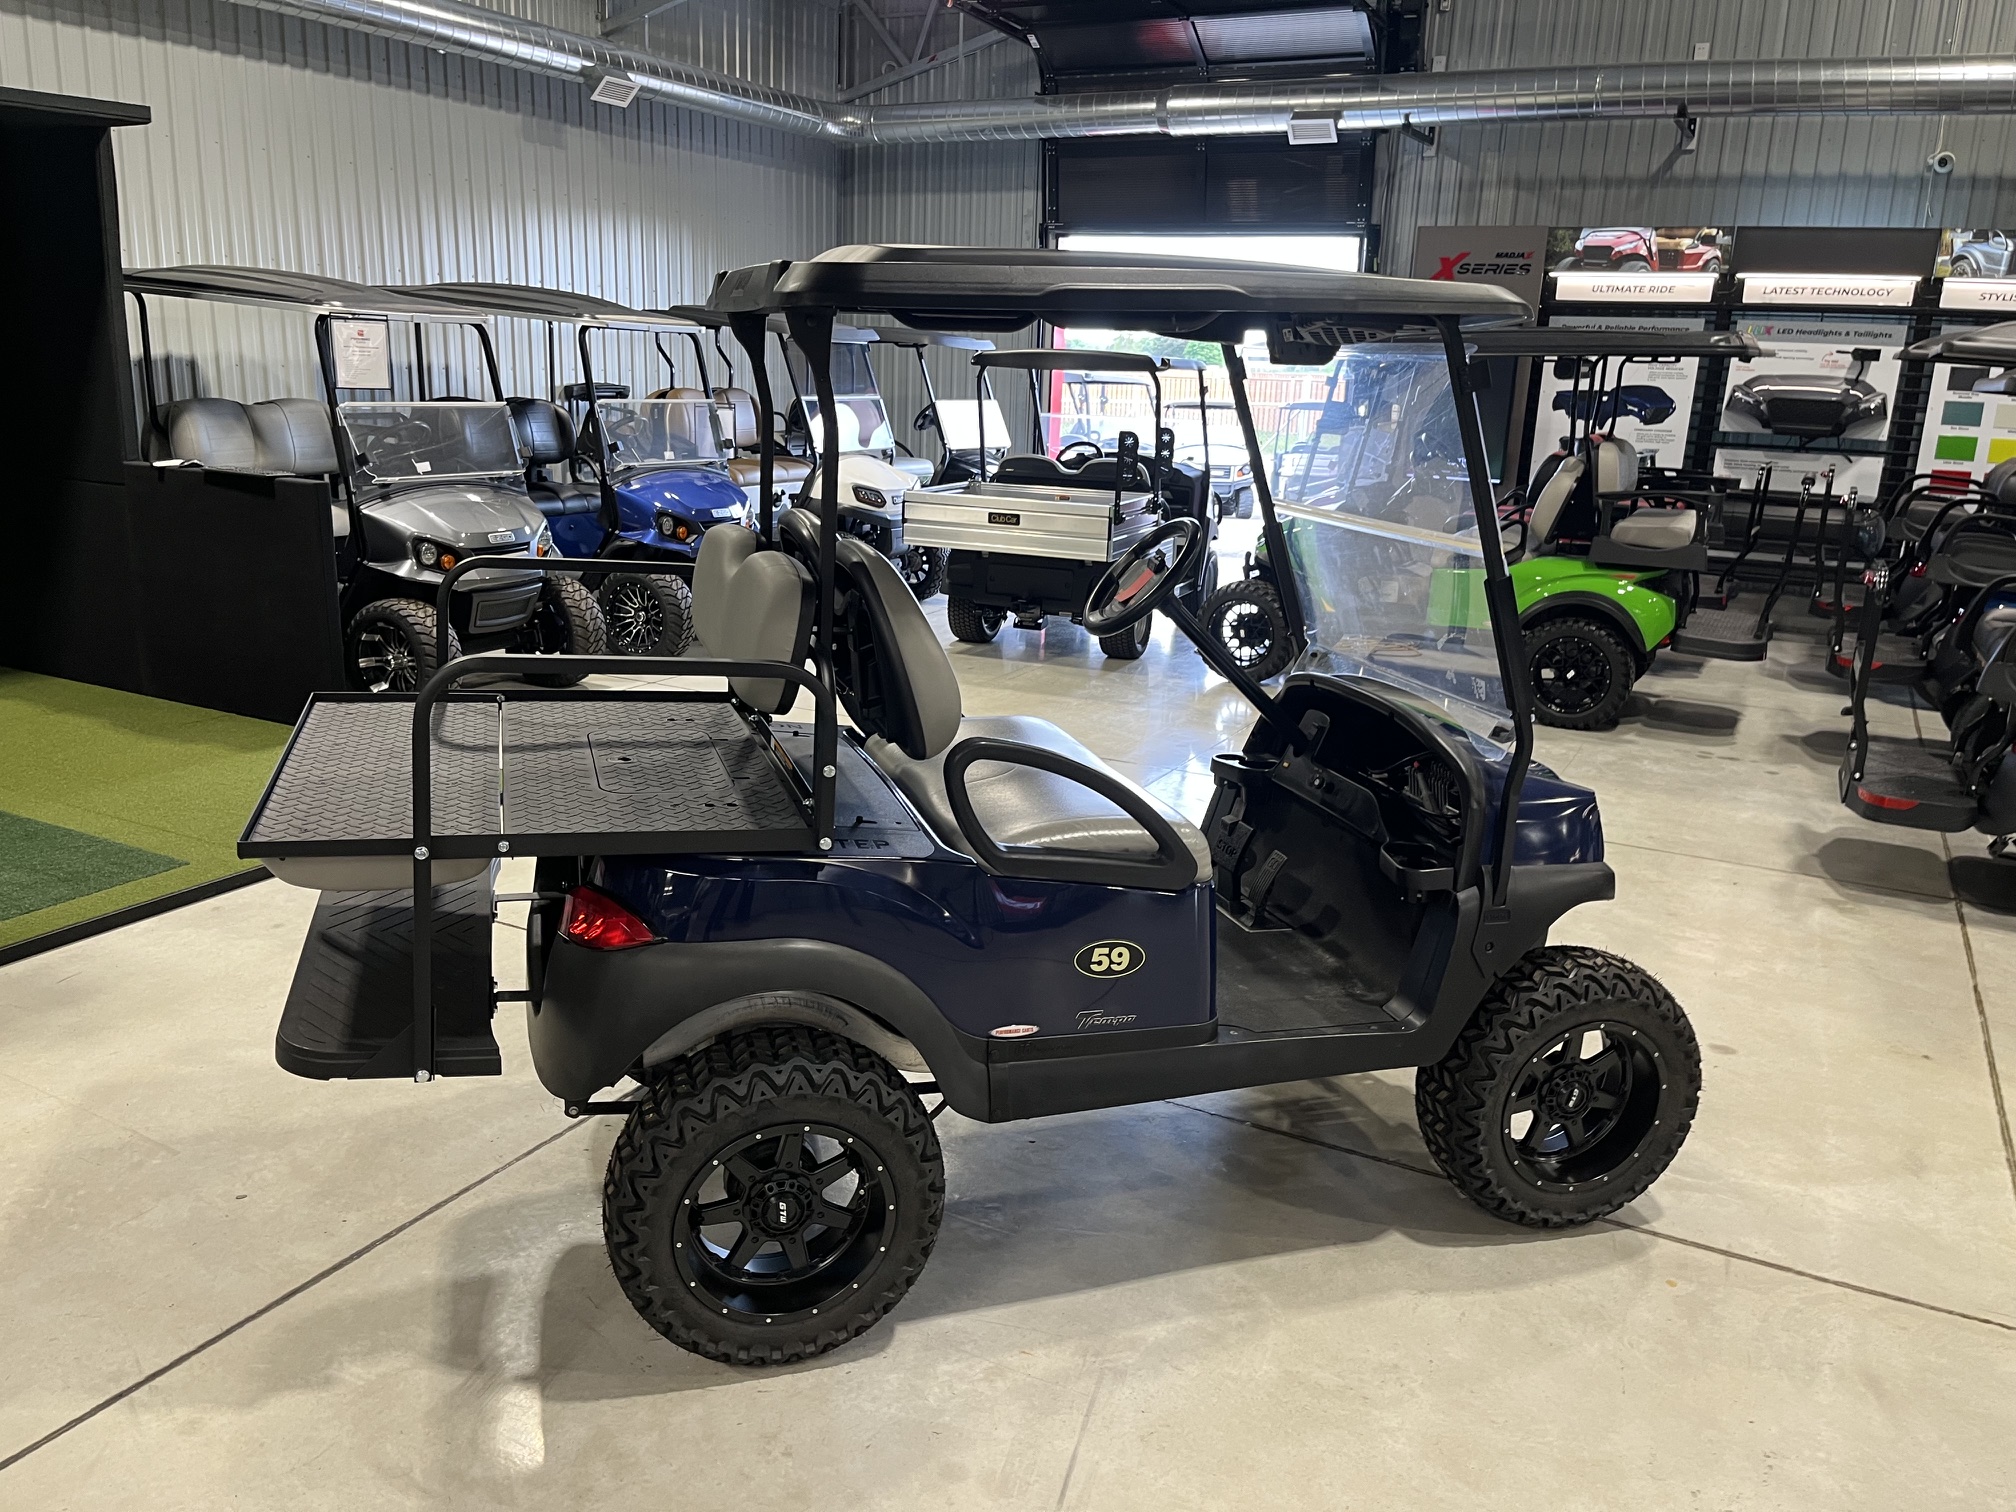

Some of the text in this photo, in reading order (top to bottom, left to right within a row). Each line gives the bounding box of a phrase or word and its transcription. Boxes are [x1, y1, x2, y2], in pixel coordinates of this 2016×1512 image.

[1495, 251, 1535, 260] MADJAX
[1457, 263, 1531, 275] SERIES
[1592, 284, 1676, 294] ULTIMATE RIDE
[1762, 286, 1894, 297] LATEST TECHNOLOGY
[1777, 327, 1794, 335] LED
[1795, 328, 1842, 337] Headlights
[1853, 330, 1892, 339] Taillights
[991, 514, 1018, 524] Club Car
[834, 838, 890, 850] TEP
[1089, 946, 1131, 972] 59
[778, 1201, 787, 1224] GTW
